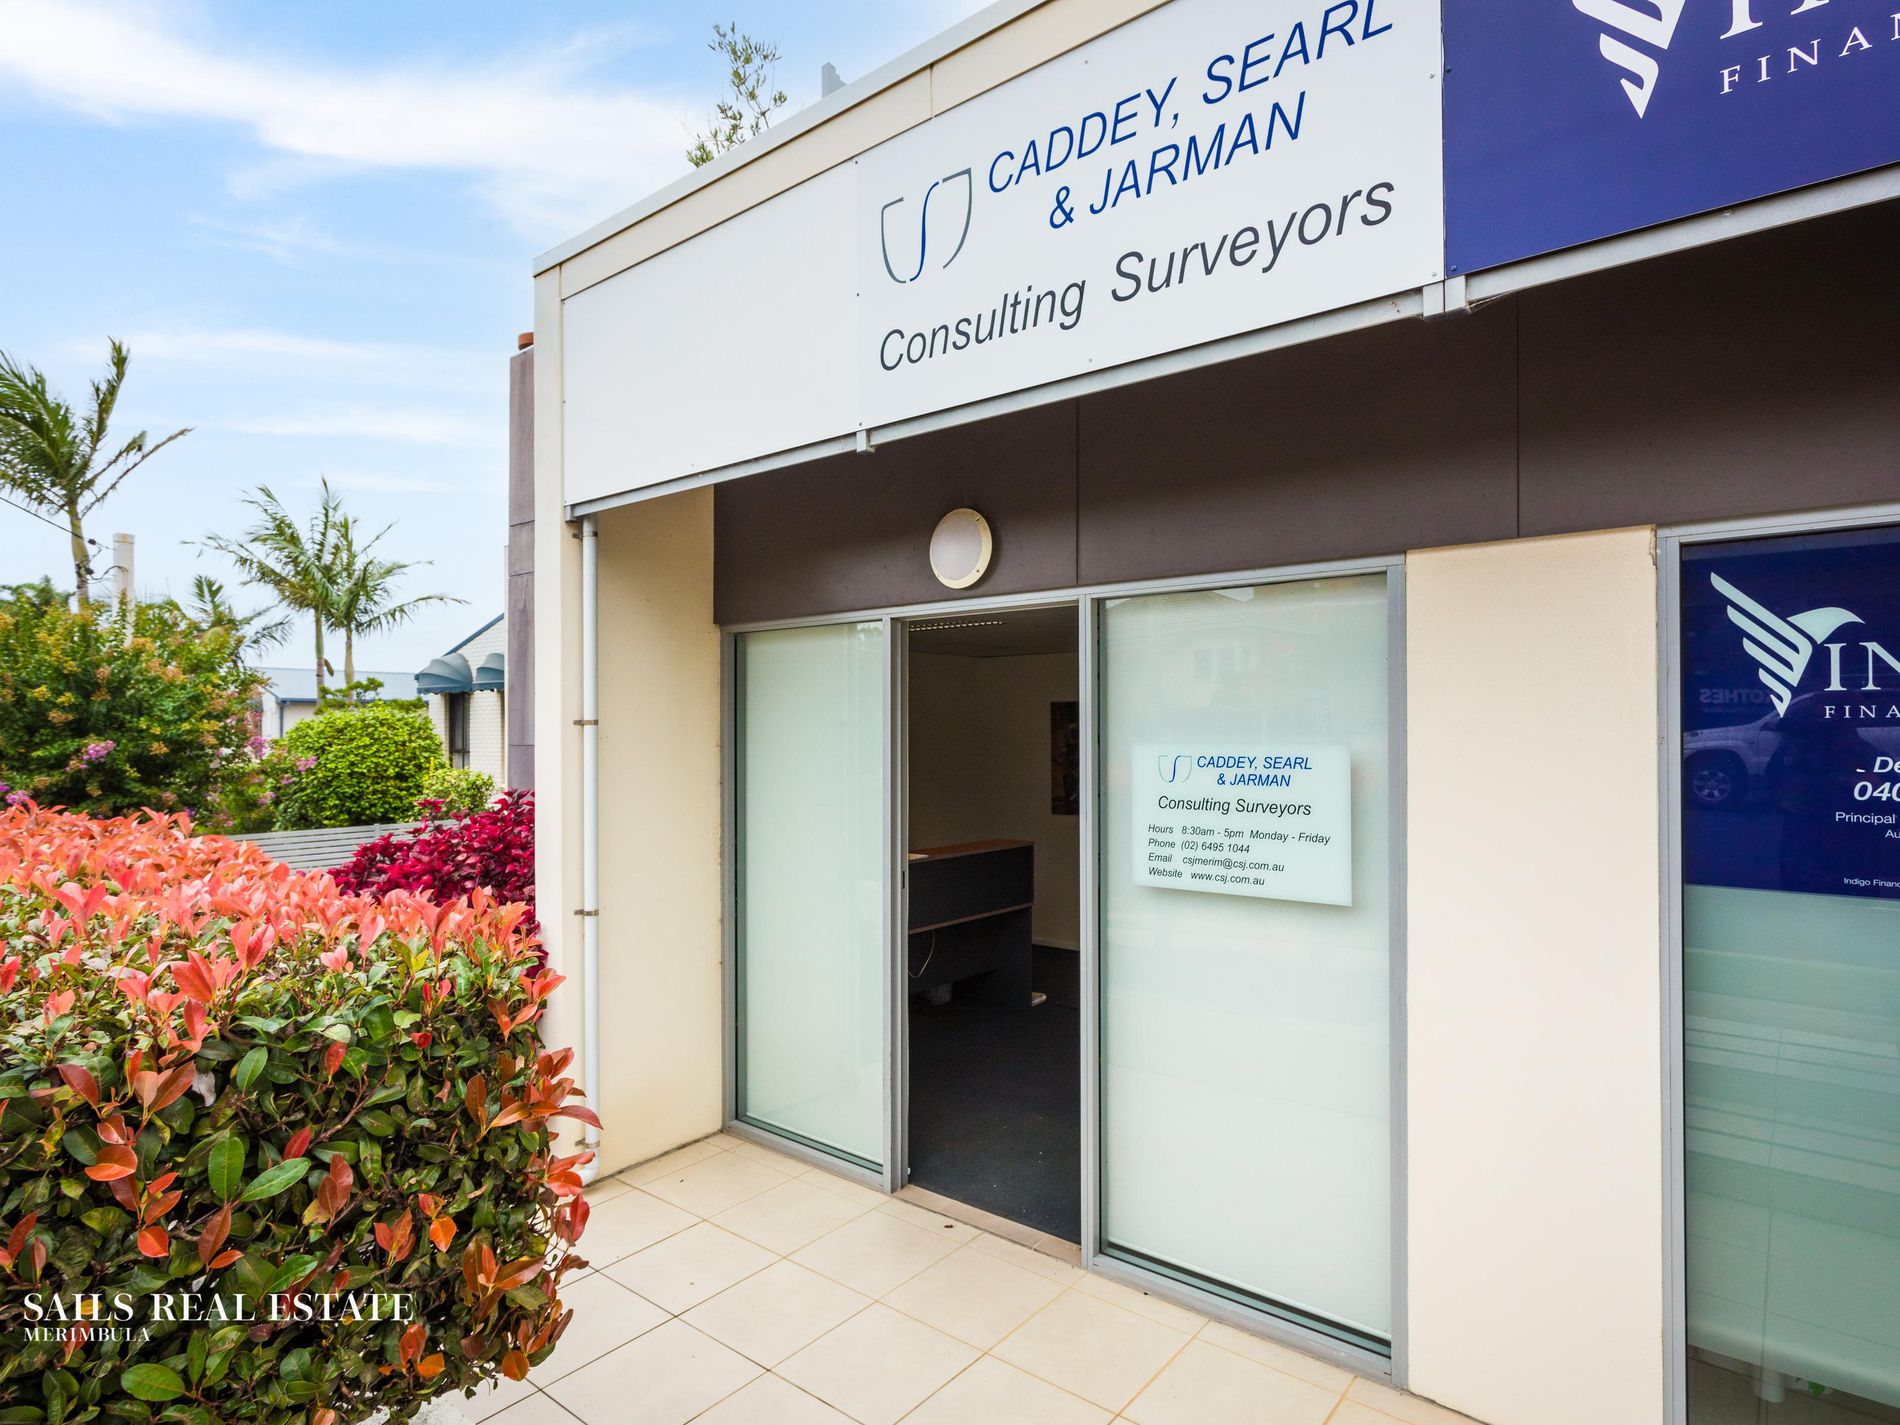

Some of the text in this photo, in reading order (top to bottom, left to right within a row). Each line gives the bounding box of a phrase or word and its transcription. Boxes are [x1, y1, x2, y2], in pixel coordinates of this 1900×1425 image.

[988, 0, 1393, 193] CADDEY, SEARL
[1049, 91, 1306, 229] & JARMAN
[879, 181, 1395, 372] Consulting Surveyors
[1824, 704, 1900, 718] FINA
[1197, 756, 1312, 770] CADDEY, SEARL
[1217, 773, 1291, 787] & JARMAN
[1158, 795, 1312, 818] Consulting Surveyors
[1835, 811, 1896, 825] Principal
[1148, 824, 1174, 834] Hours
[1181, 826, 1215, 836] 8:30am
[1223, 828, 1244, 839] 5pm
[1249, 830, 1289, 843] Monday
[1298, 832, 1331, 846] Friday
[1148, 838, 1250, 853] Phone (02) 6495 1044
[1148, 852, 1285, 872] Email csjmerim@csj.com.au
[1148, 867, 1265, 886] Website www.csj.com.au
[1843, 877, 1871, 887] Indigo
